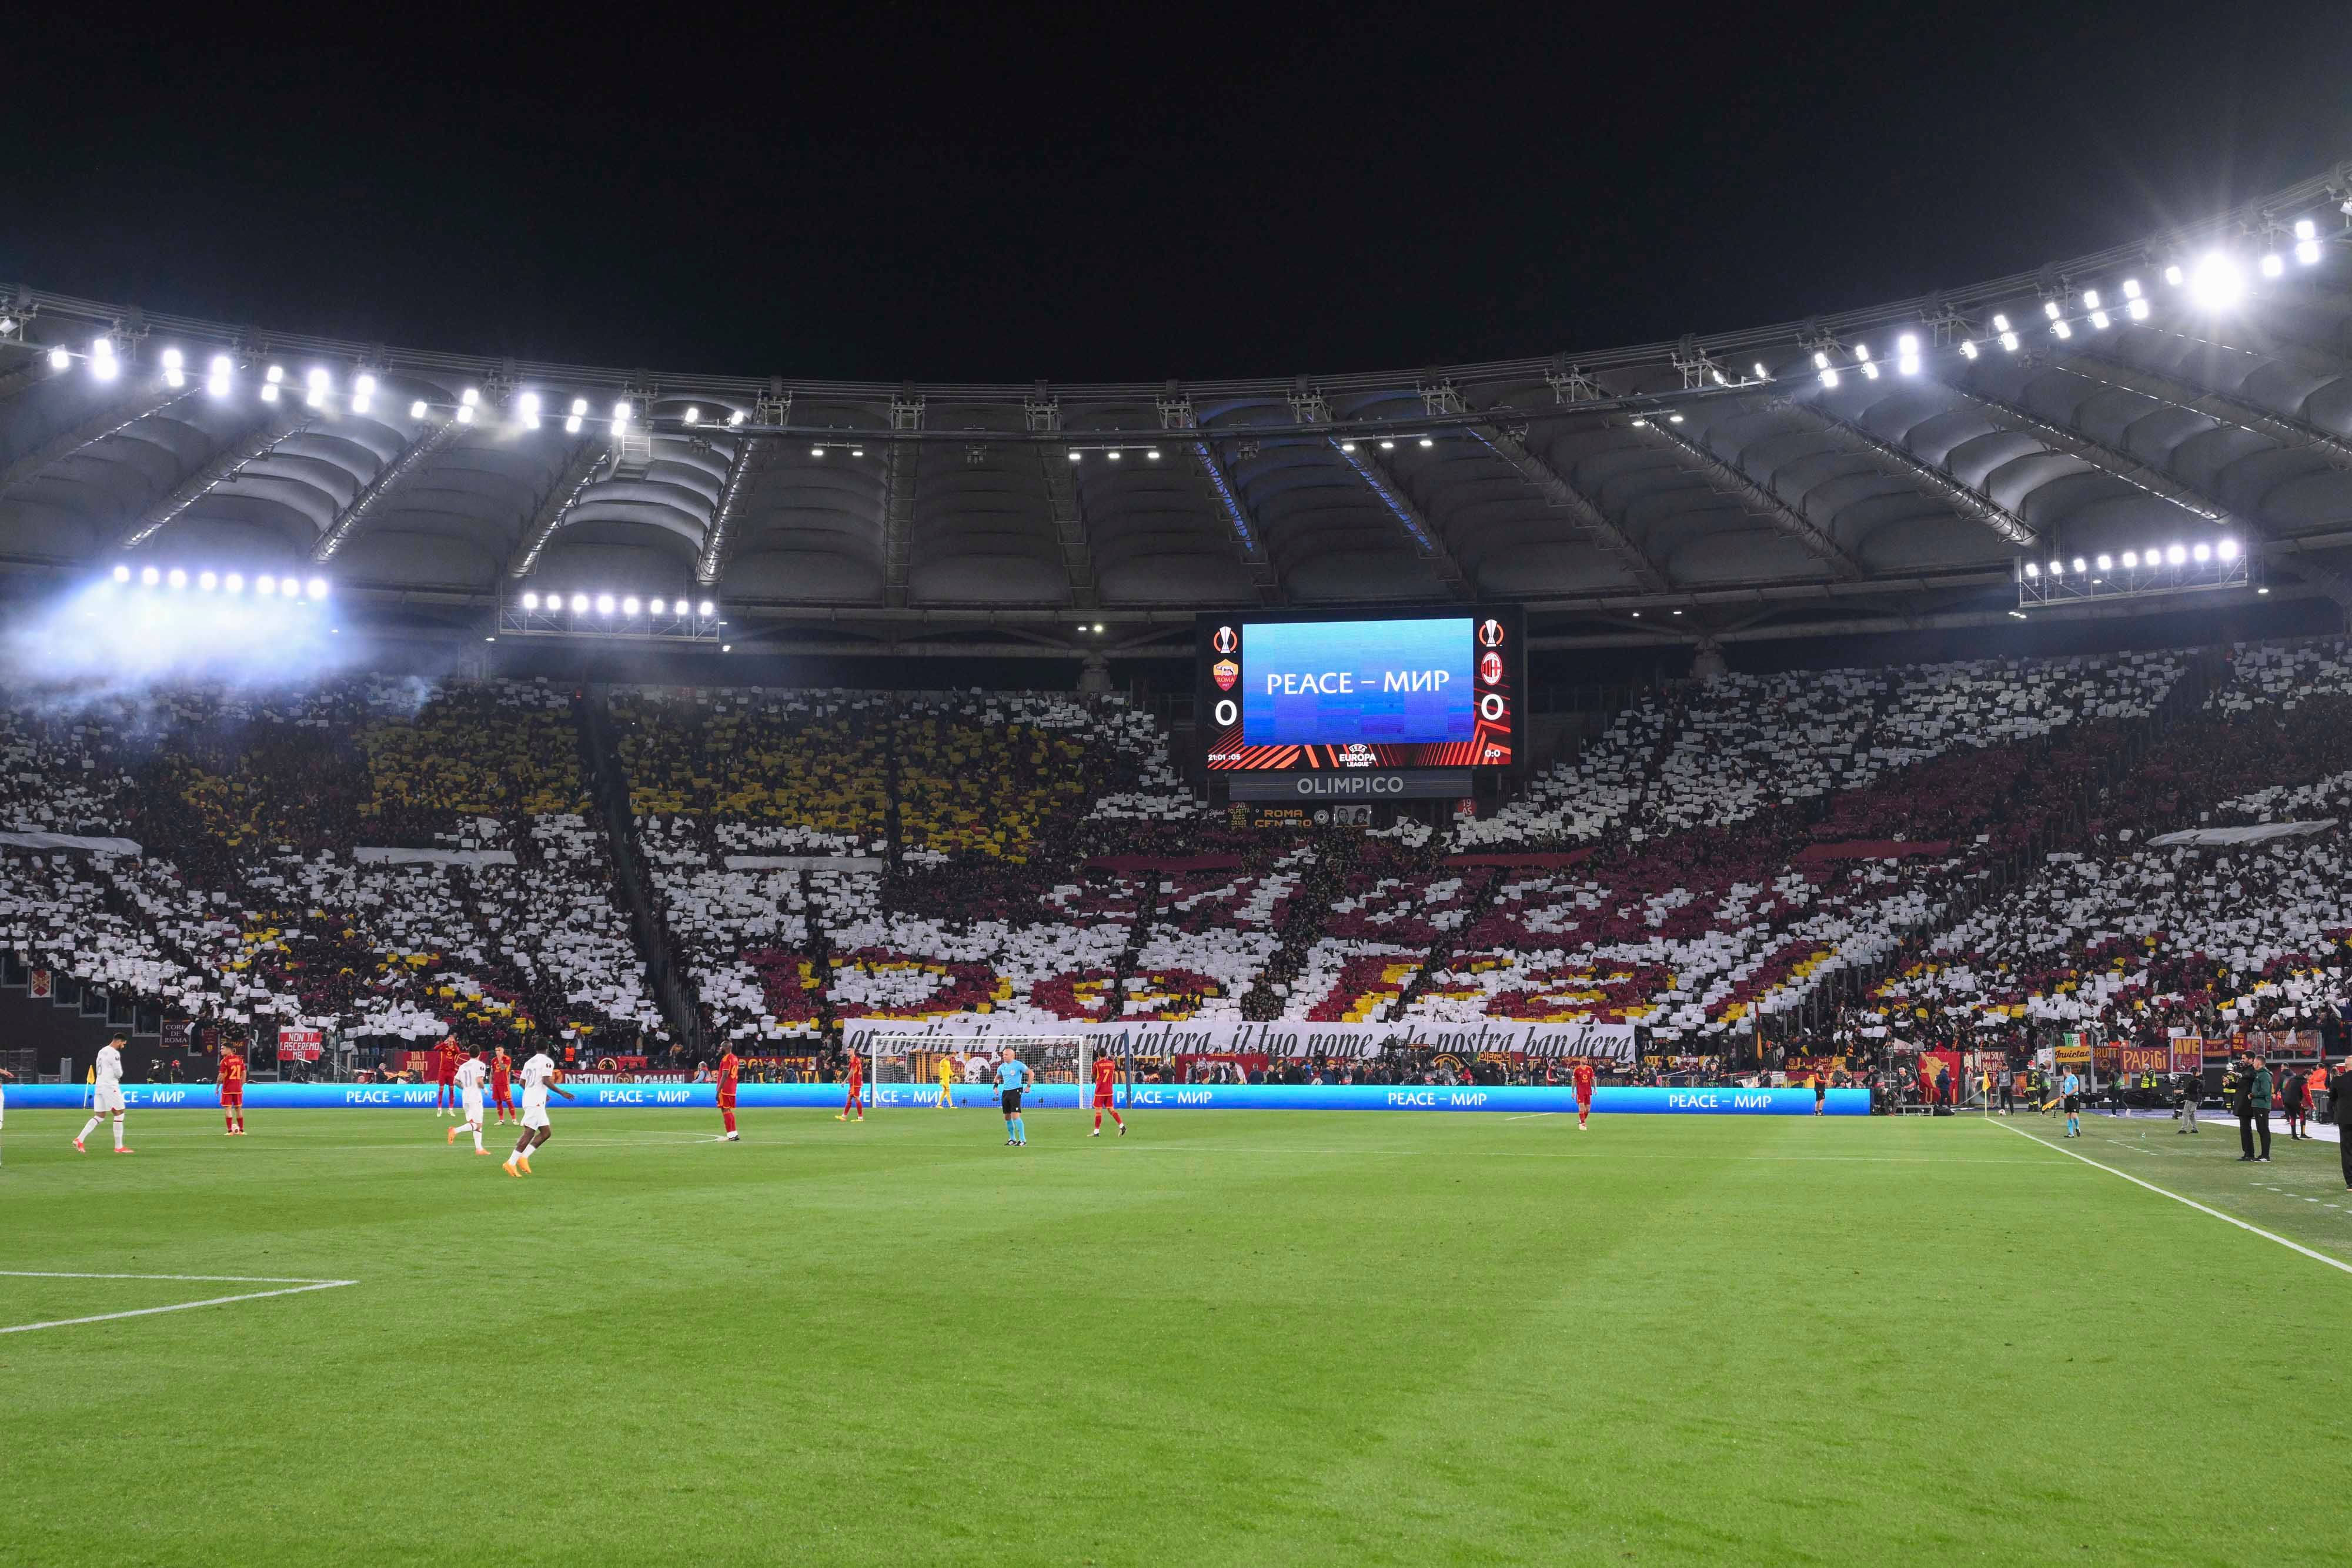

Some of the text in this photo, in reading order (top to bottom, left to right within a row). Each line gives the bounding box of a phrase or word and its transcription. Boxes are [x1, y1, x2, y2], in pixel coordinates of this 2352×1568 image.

[1267, 672, 1354, 695] PEACE
[1384, 670, 1449, 693] МИР
[1215, 700, 1237, 726] 0
[1481, 694, 1504, 720] 0
[1339, 753, 1377, 761] EUROPA
[1485, 749, 1501, 757] 0:0
[1297, 776, 1404, 794] OLIMPICO
[1462, 798, 1472, 807] 19
[1264, 809, 1303, 818] ROMA
[288, 1033, 313, 1042] NON TI
[1231, 1024, 1253, 1054] il
[1258, 1024, 1298, 1057] tuo
[1305, 1033, 1373, 1058] nome
[1435, 1024, 1515, 1052] nostra
[1522, 1025, 1632, 1061] bandiera
[280, 1042, 320, 1051] LASCEREMO
[2174, 1039, 2200, 1054] AVE
[292, 1051, 306, 1060] MAI
[229, 1065, 241, 1079] 21
[1102, 1069, 1110, 1082] 7
[152, 1091, 185, 1103] МИР
[346, 1091, 389, 1103] PEACE
[404, 1091, 437, 1103] МИР
[600, 1091, 643, 1103] PEACE
[657, 1091, 690, 1102] МИР
[1177, 1091, 1212, 1104] МИР
[1388, 1092, 1435, 1106] PEACE
[1451, 1093, 1486, 1106] МИР
[1669, 1095, 1718, 1108] PEACE
[1734, 1095, 1772, 1108] МИР
